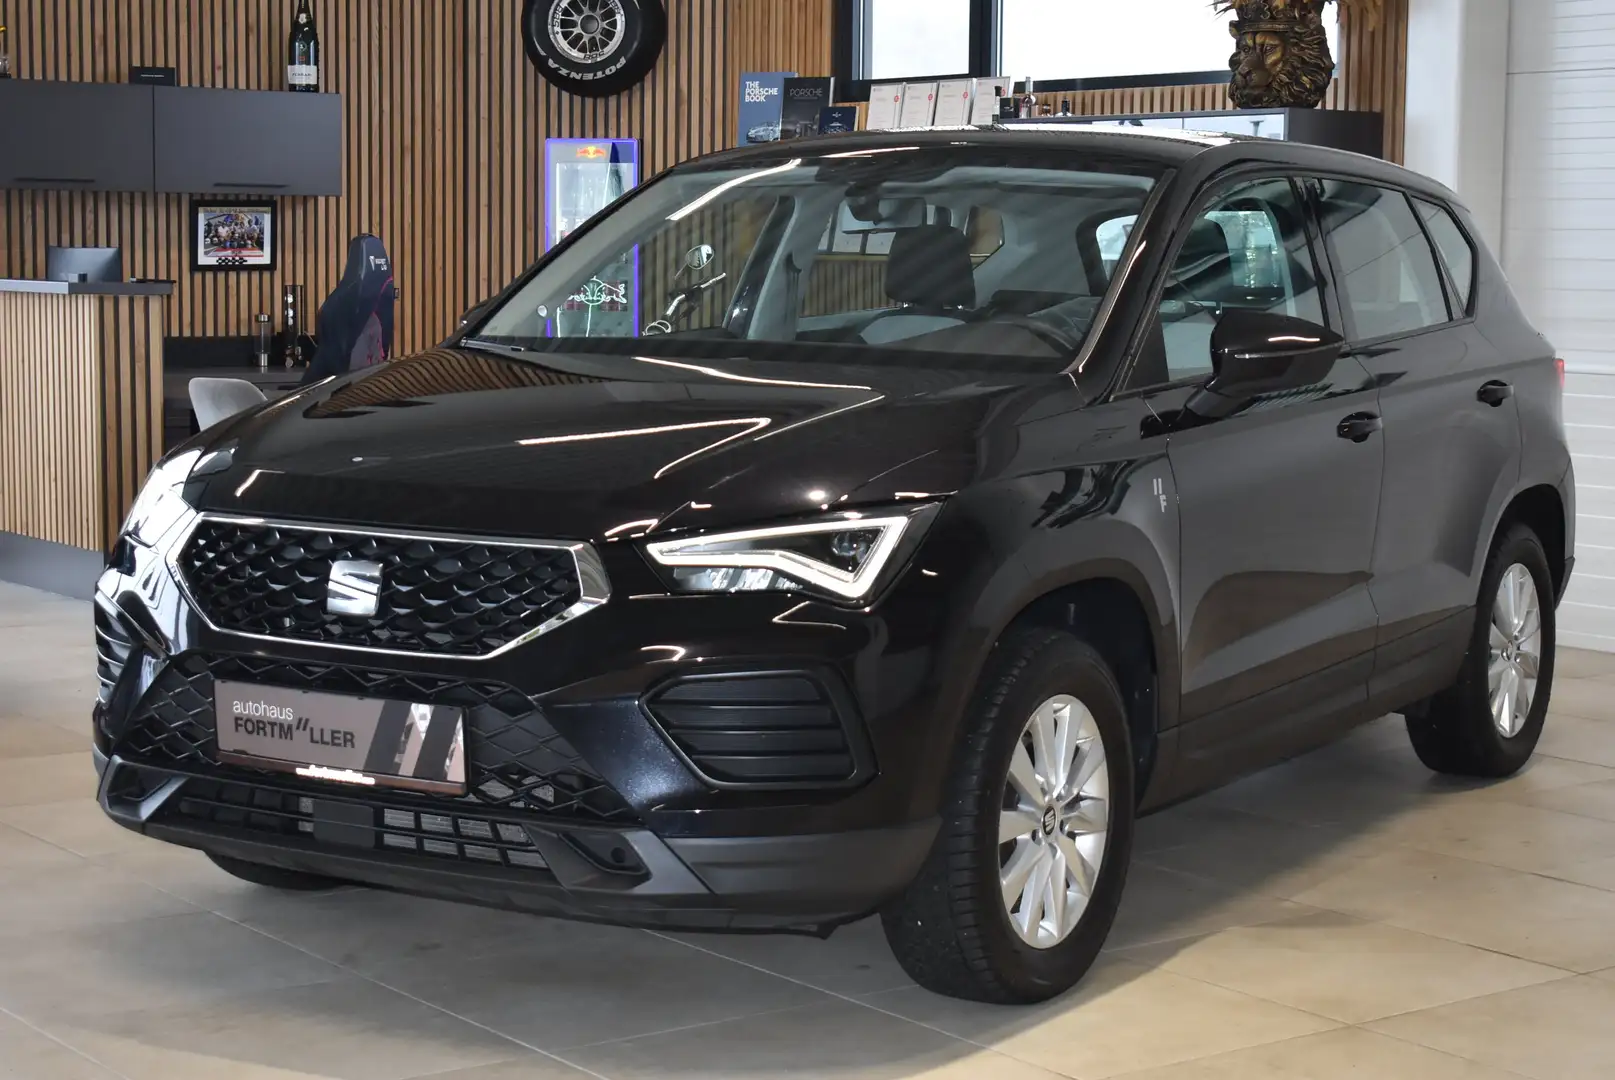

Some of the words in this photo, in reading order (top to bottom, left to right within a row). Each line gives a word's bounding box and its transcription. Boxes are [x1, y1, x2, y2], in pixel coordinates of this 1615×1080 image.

[547, 56, 627, 81] POTENZA
[745, 81, 760, 89] THE
[745, 88, 779, 96] PORSCHE
[789, 87, 823, 97] PORSCHE
[232, 700, 294, 720] autohaus
